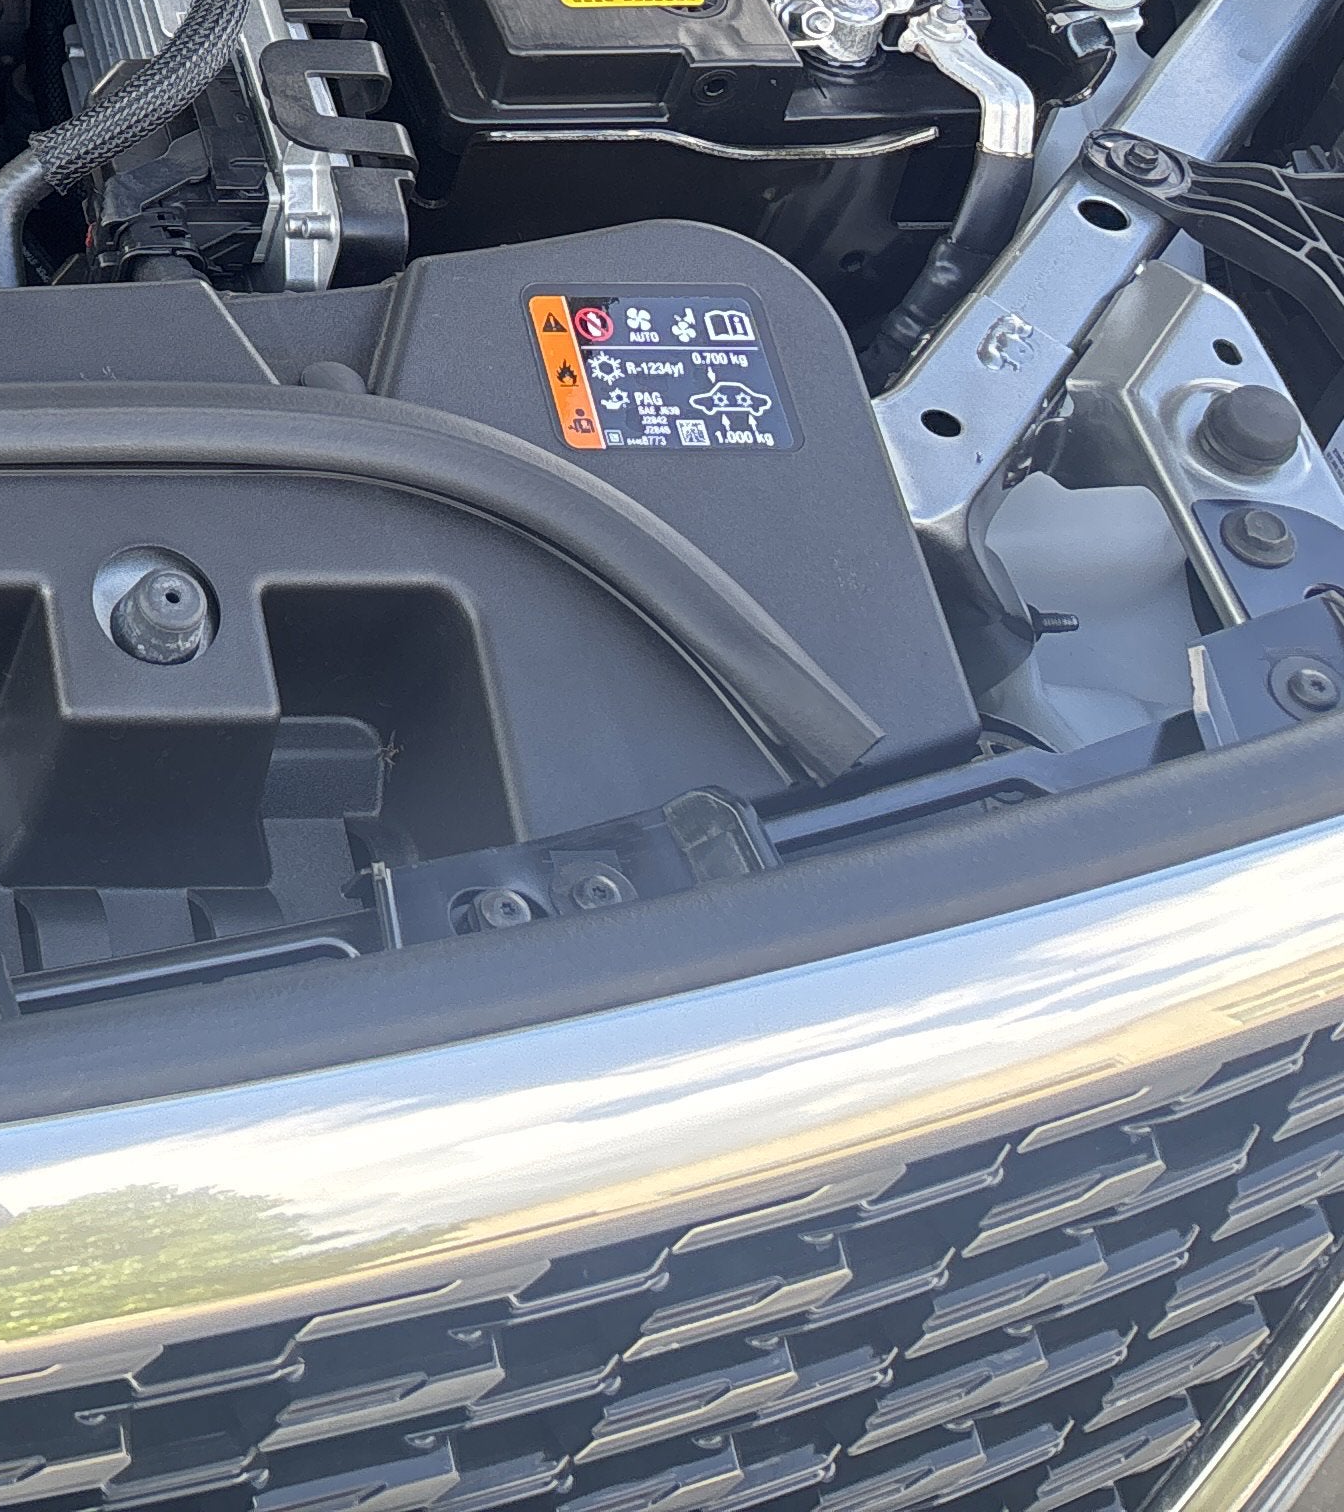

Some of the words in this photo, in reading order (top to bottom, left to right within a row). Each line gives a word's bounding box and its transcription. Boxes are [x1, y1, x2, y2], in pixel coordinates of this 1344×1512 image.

[629, 331, 660, 343] AUTO
[691, 352, 729, 365] 0.700
[730, 352, 749, 368] kg
[633, 392, 663, 405] PAG
[715, 430, 753, 444] 1.000
[754, 430, 775, 447] kg
